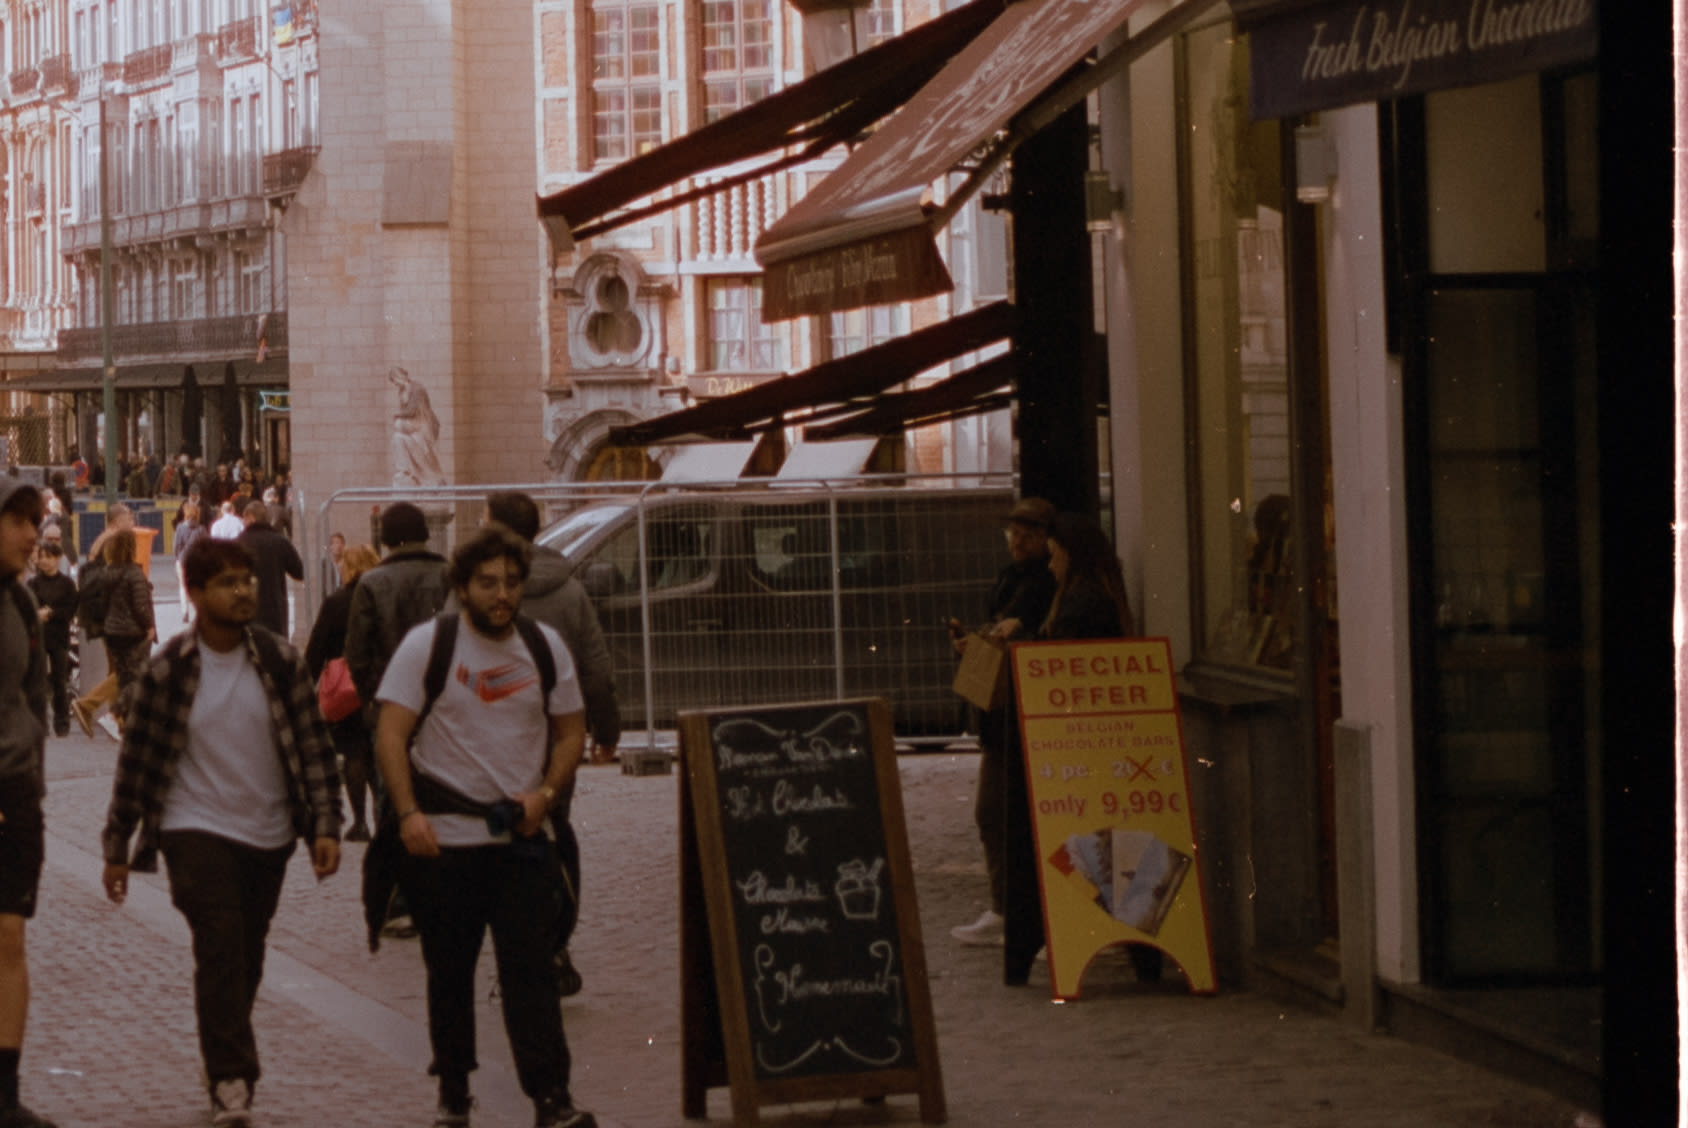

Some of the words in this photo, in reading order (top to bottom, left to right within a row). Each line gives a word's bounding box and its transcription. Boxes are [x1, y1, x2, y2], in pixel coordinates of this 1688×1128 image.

[1302, 5, 1366, 80] Fresh
[1027, 656, 1161, 678] SPECIAL
[1048, 685, 1148, 708] OFFER
[1066, 721, 1134, 734] BELGIAN
[1031, 737, 1125, 752] CHOCOLATE
[1132, 735, 1175, 748] BARS
[1039, 794, 1086, 817] only
[786, 824, 810, 855] &
[774, 963, 889, 1004] Homemade
